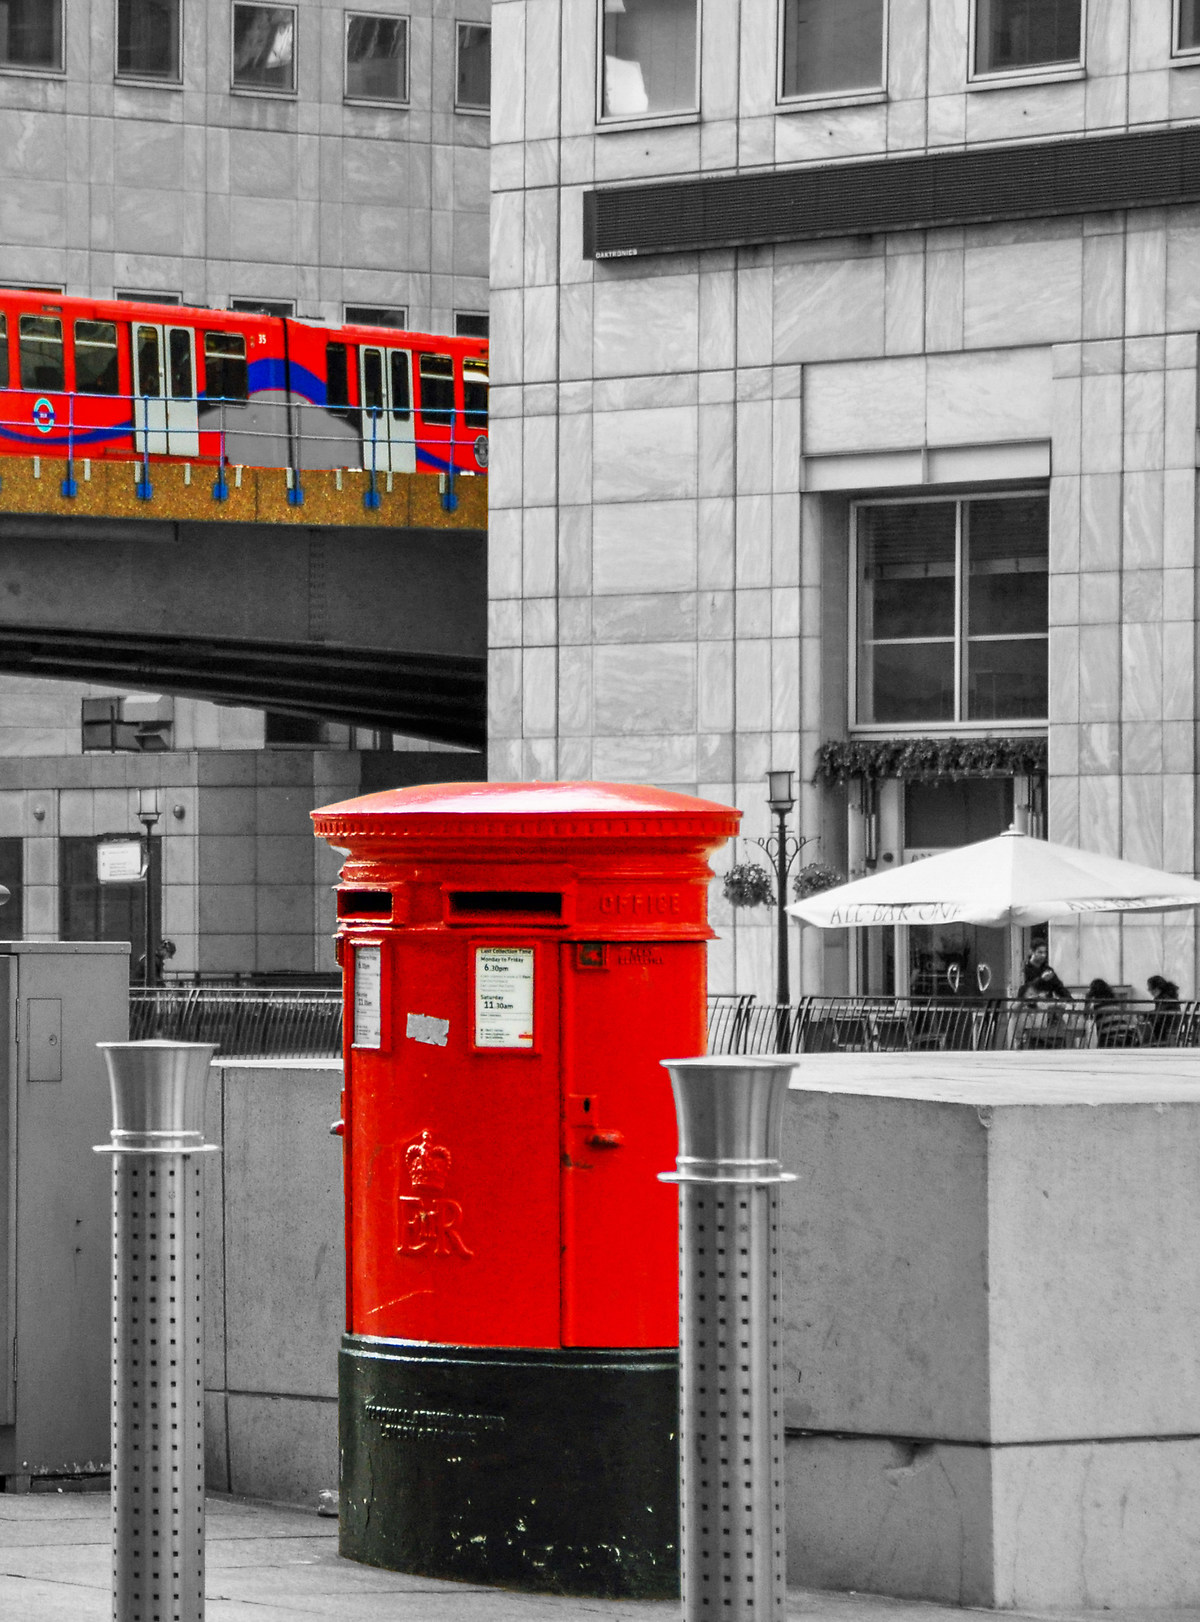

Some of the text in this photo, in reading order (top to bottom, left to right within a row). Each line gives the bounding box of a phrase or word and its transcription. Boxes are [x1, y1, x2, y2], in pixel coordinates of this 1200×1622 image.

[595, 248, 638, 259] DAKTRONICS
[258, 334, 266, 344] 35
[600, 895, 680, 915] OFFICE
[830, 904, 863, 925] ALL
[484, 963, 509, 972] 6.30pm
